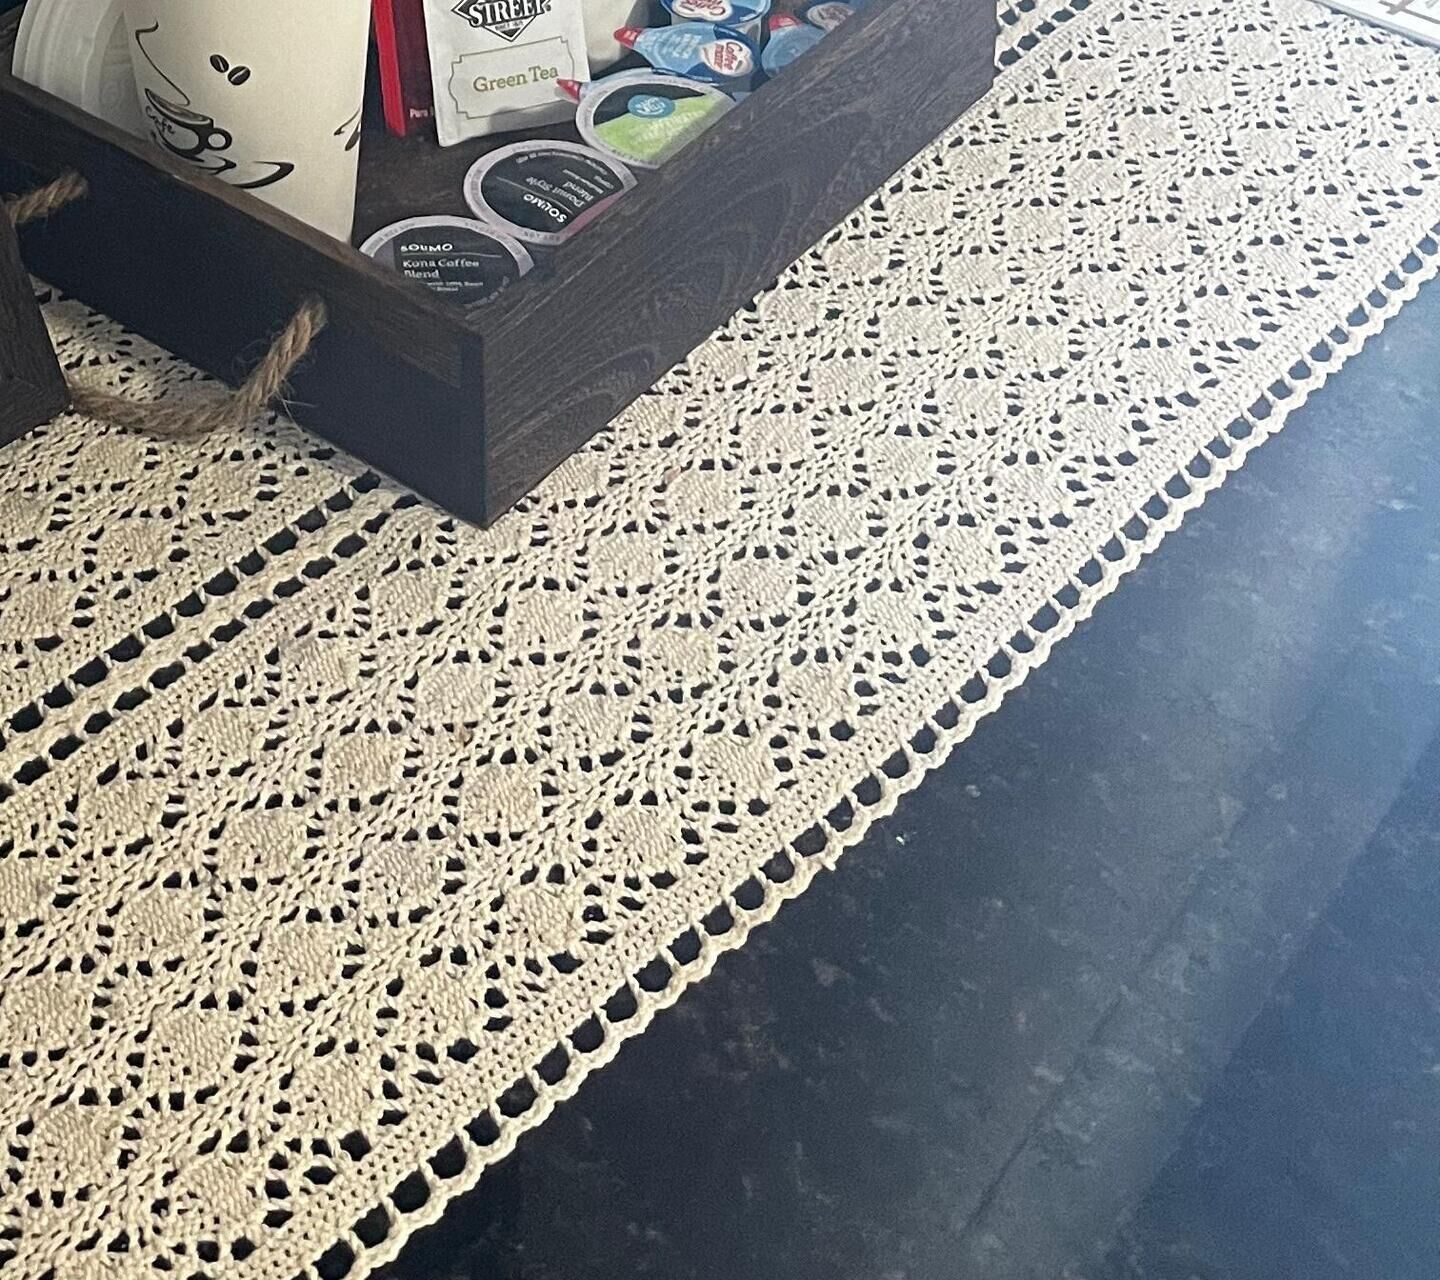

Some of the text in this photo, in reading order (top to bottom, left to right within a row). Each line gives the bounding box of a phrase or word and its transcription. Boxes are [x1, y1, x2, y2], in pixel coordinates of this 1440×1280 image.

[473, 65, 558, 92] Green Tea
[526, 176, 553, 191] Style
[562, 181, 594, 202] Blend
[552, 187, 585, 208] Donut
[403, 258, 479, 268] Kona Coffee
